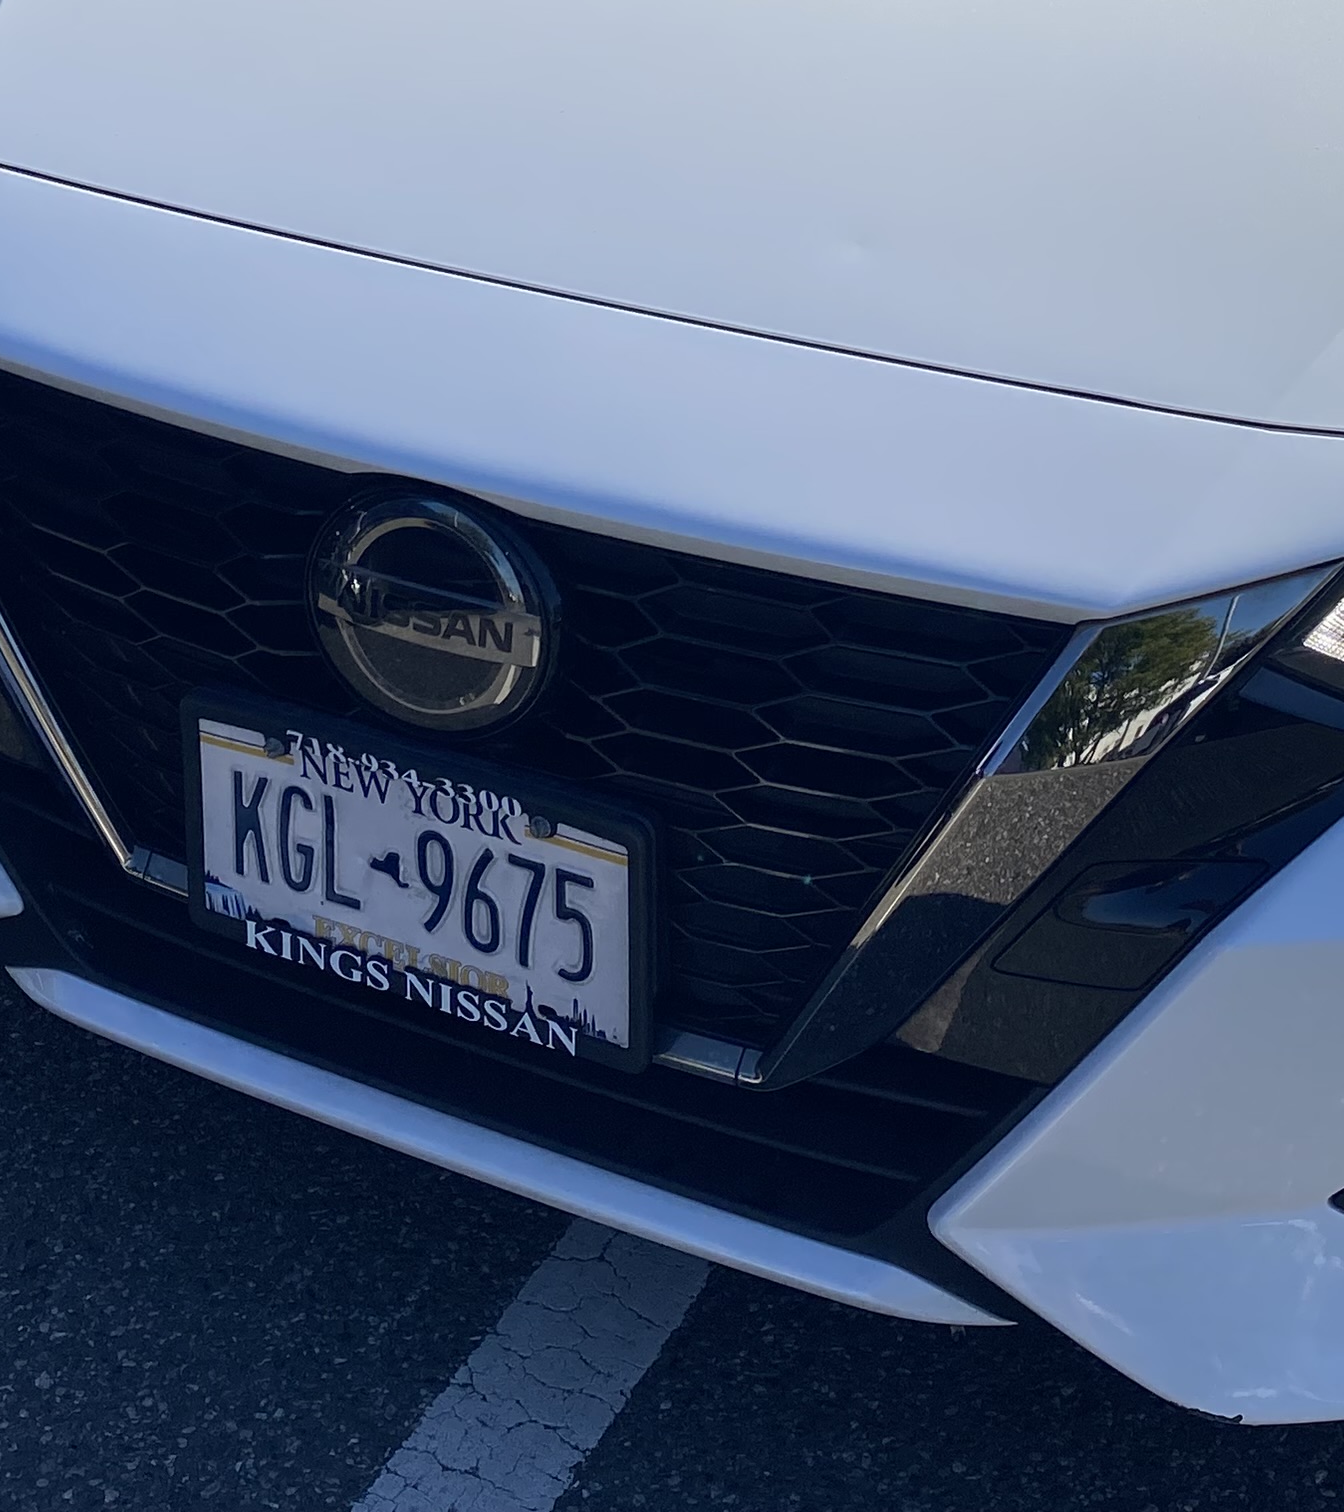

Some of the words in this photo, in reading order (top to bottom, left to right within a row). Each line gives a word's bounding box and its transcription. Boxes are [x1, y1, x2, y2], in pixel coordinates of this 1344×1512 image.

[338, 580, 515, 653] NISSAN
[285, 729, 523, 819] 718-934-3300
[299, 745, 390, 805] NEW
[405, 781, 523, 846] YORK
[232, 769, 362, 910] KGL
[416, 829, 594, 983] 9675
[245, 919, 391, 992] KINGS
[404, 971, 579, 1057] NISSAN
[312, 914, 510, 1000] EXCELSIOR
